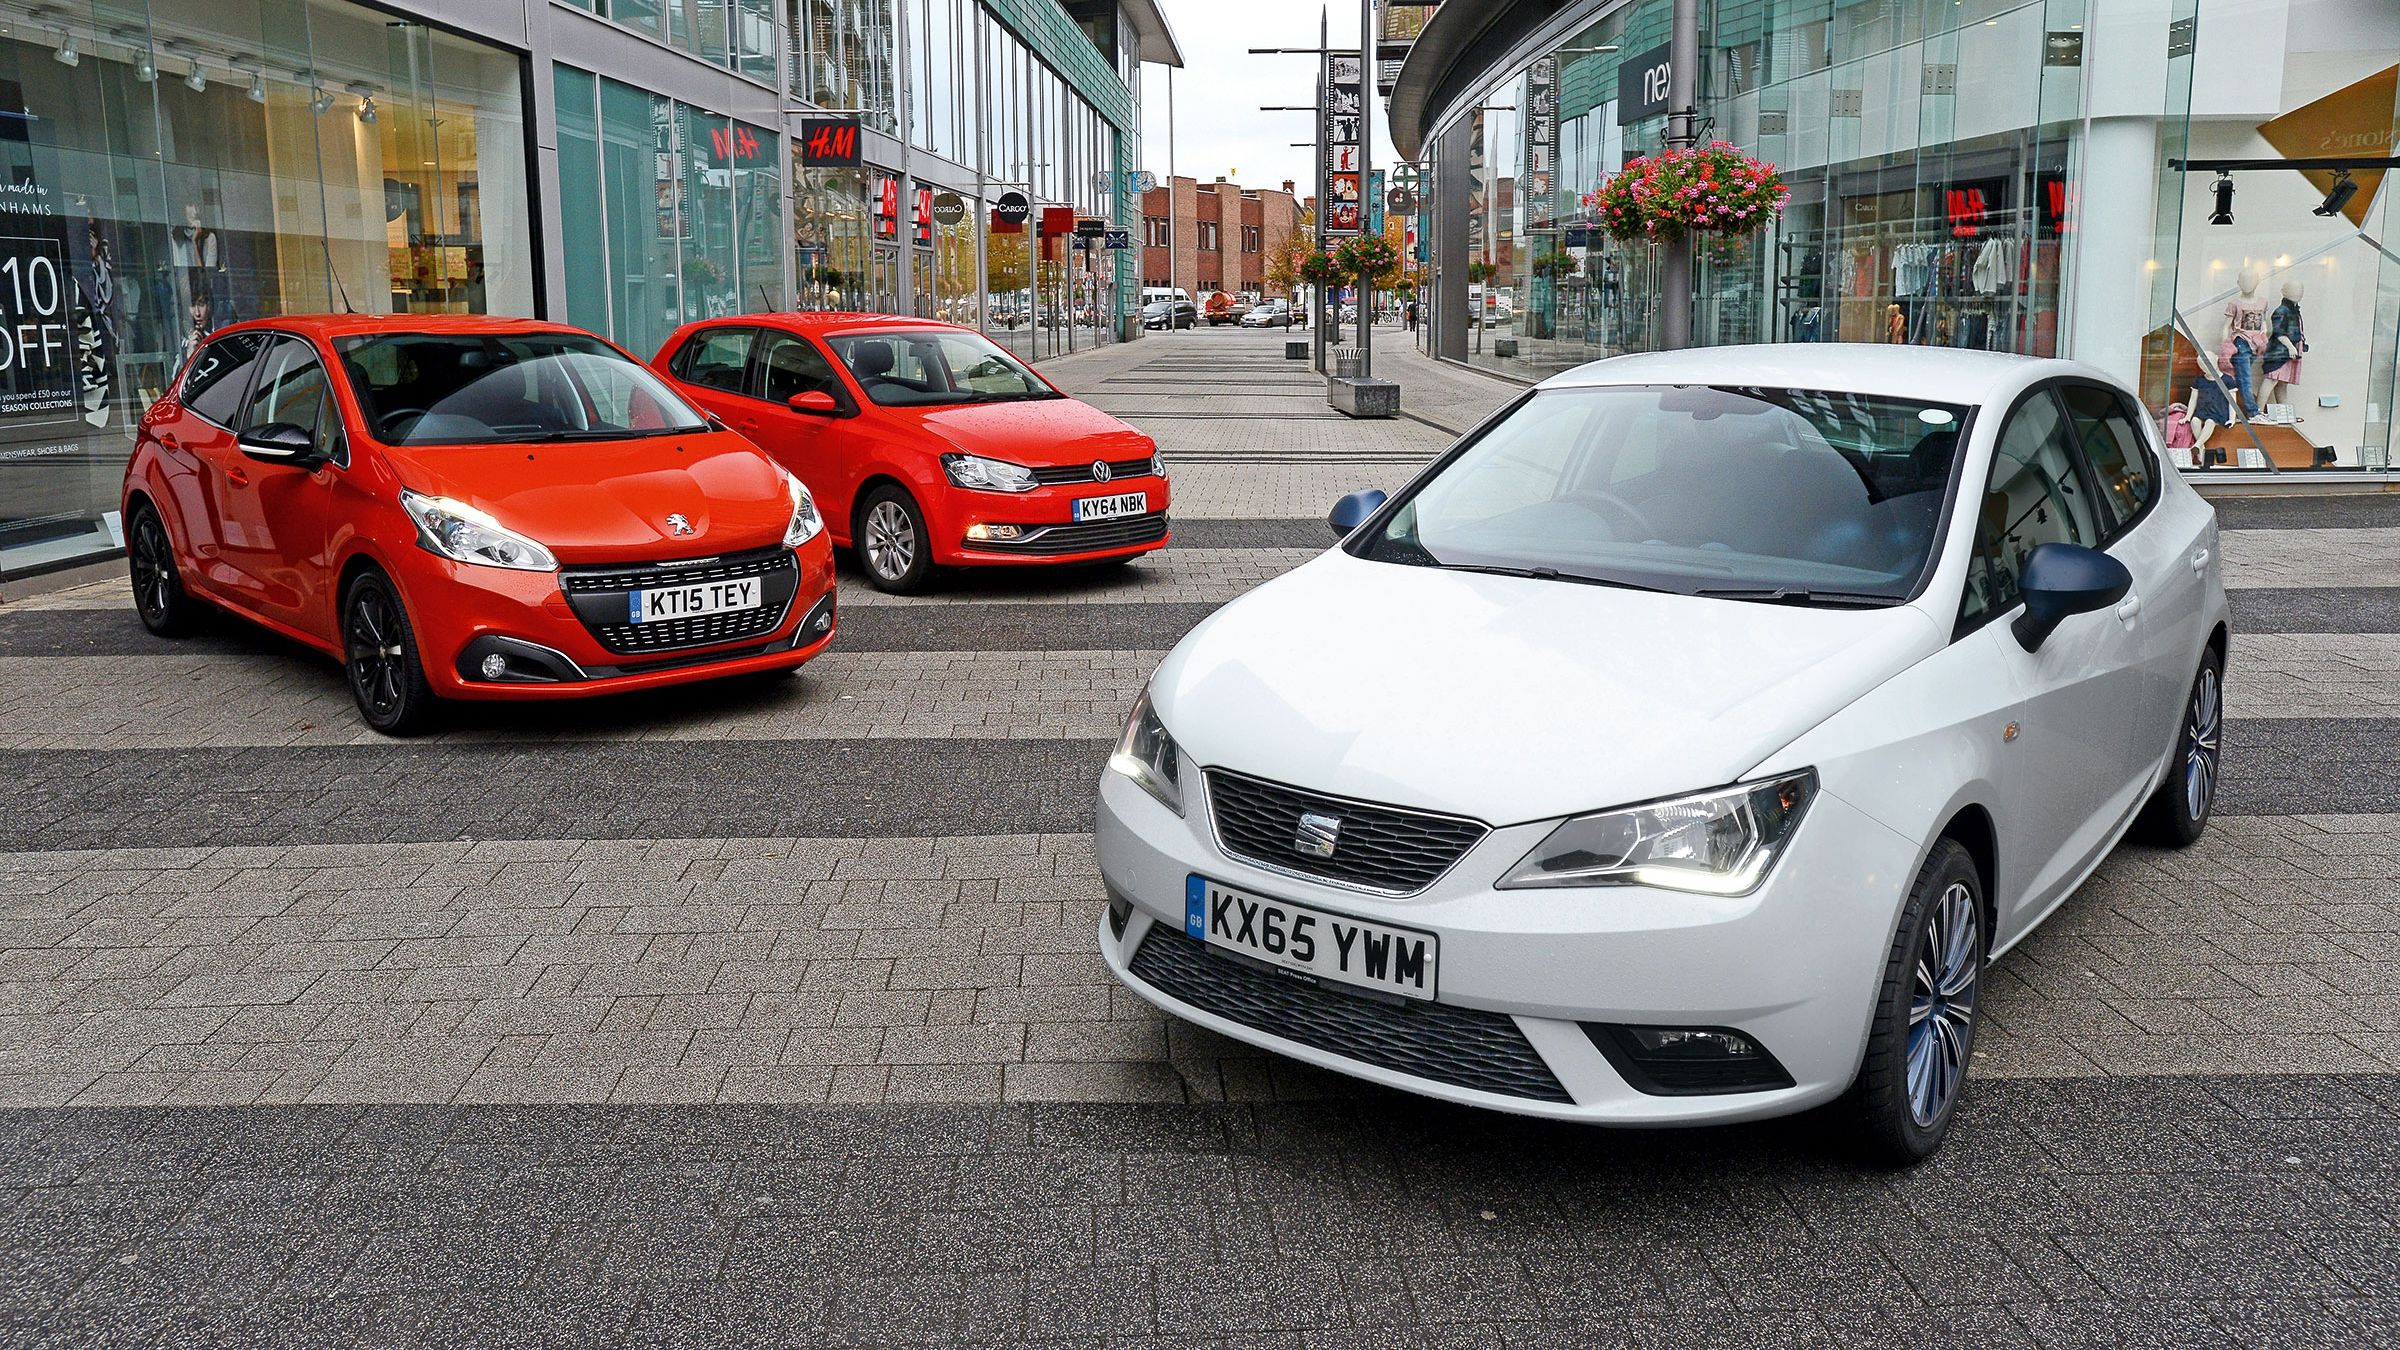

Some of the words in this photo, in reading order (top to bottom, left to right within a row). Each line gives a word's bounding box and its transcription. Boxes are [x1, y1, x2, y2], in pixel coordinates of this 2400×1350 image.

[807, 125, 856, 160] H&M
[8, 177, 35, 195] made
[36, 184, 48, 195] in
[0, 256, 58, 316] 10
[1, 404, 29, 413] SEASON
[29, 400, 73, 411] COLLECTIONS
[2, 394, 15, 403] you
[16, 391, 37, 401] spend
[38, 389, 50, 398] £50
[37, 446, 58, 456] SHOES
[63, 443, 79, 453] BAGS
[1082, 498, 1117, 518] KY64
[1120, 494, 1144, 513] NBK
[651, 588, 703, 616] KT15
[710, 582, 751, 609] TEY
[1190, 913, 1202, 928] GB
[1211, 890, 1317, 963] KX65
[1331, 922, 1425, 989] YWM
